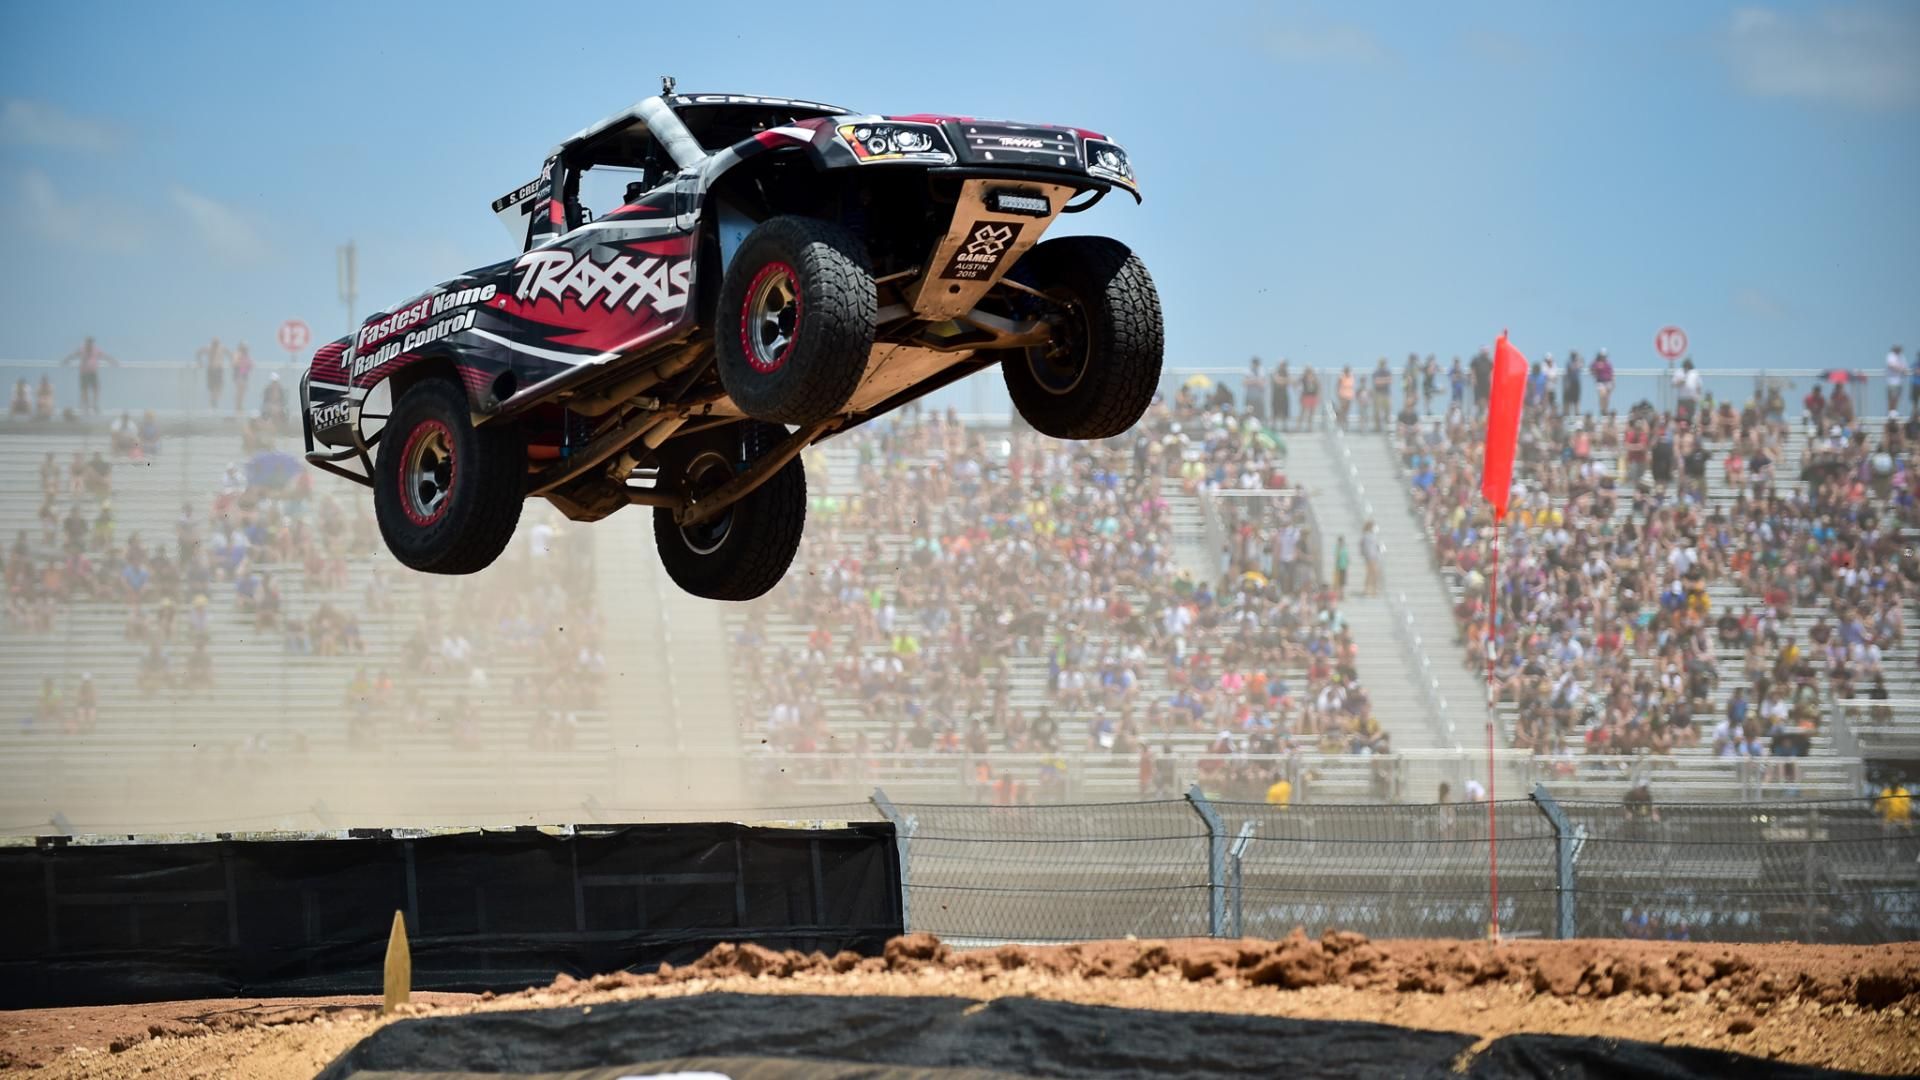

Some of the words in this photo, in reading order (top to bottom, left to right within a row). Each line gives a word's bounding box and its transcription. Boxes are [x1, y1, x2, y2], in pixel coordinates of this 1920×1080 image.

[955, 262, 988, 271] AUSTIN
[957, 253, 997, 263] GAMES
[514, 250, 691, 314] TRAXXAS
[956, 270, 977, 278] 2015
[357, 299, 430, 350] Fastest
[431, 284, 497, 317] Name
[283, 327, 304, 345] 12
[353, 341, 400, 377] Radio
[402, 309, 477, 353] Control
[1661, 333, 1683, 352] 10
